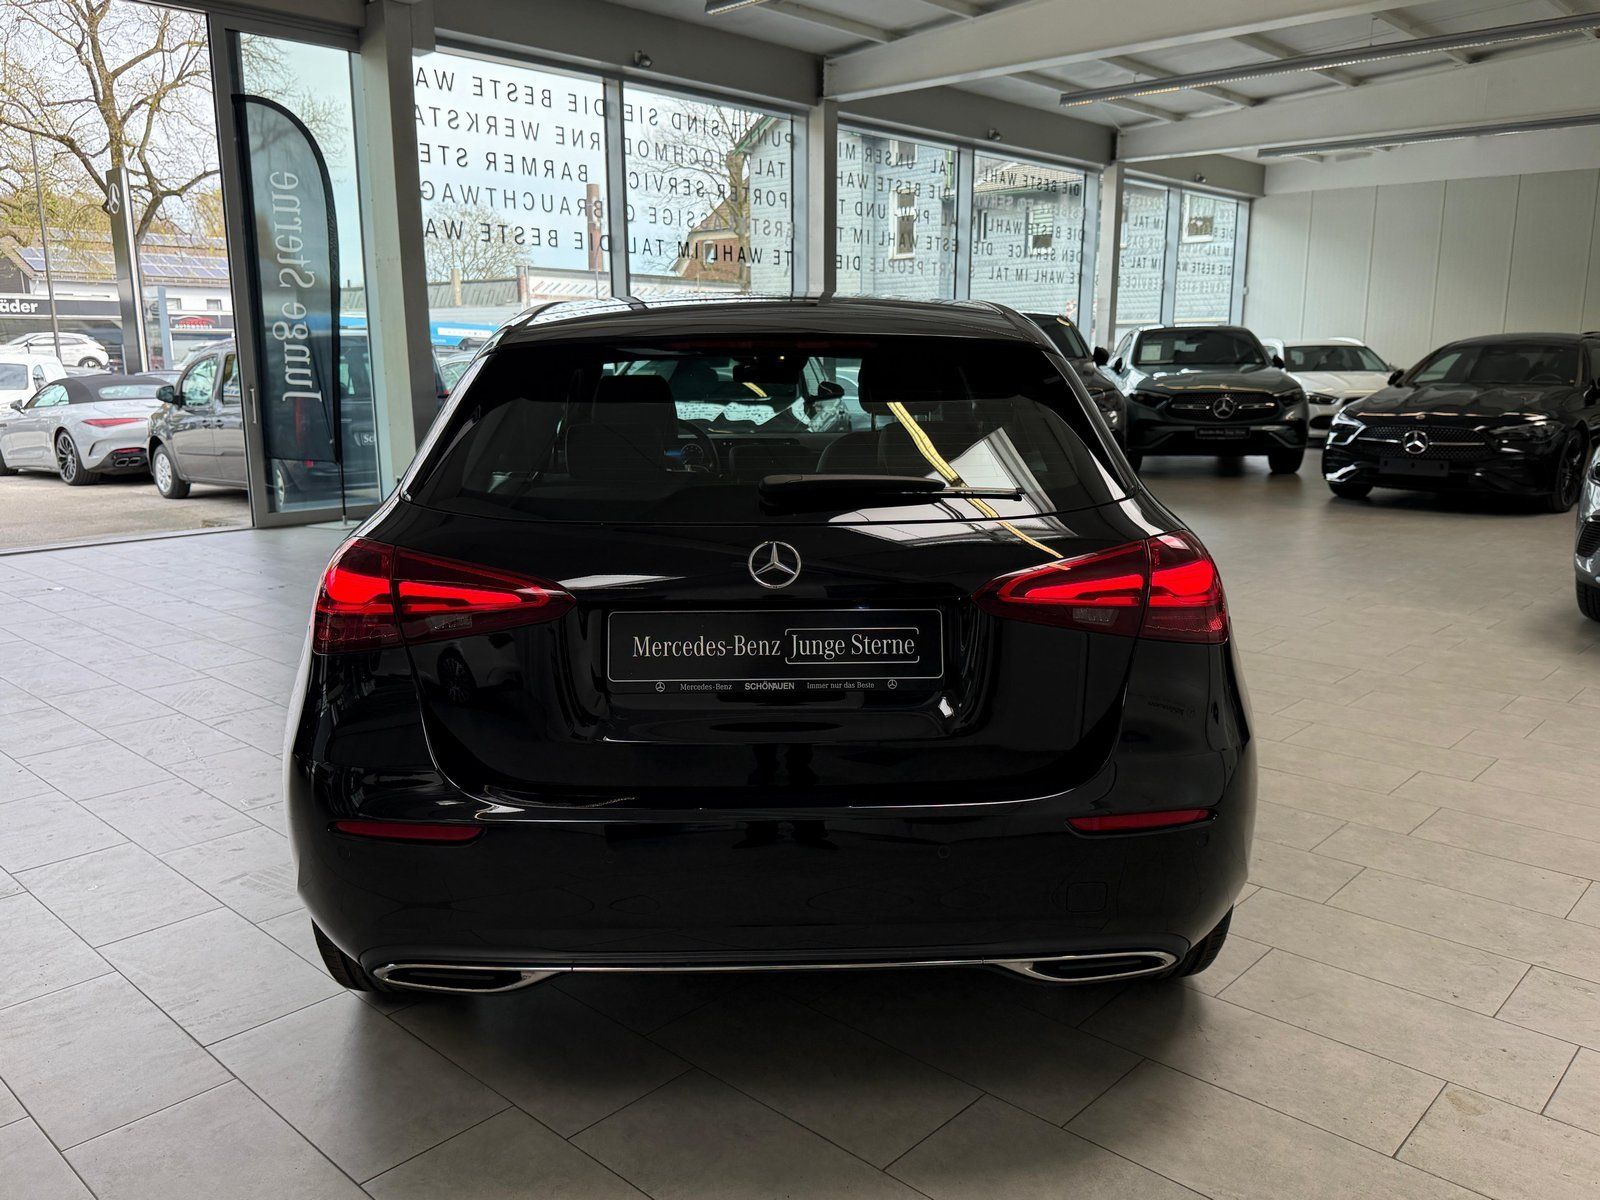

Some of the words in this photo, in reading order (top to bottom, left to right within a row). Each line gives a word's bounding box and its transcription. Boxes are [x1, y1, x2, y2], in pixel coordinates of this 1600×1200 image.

[632, 634, 781, 658] Mercedes-Benz
[790, 634, 846, 660] Junge
[850, 633, 916, 655] Sterne
[680, 683, 733, 691] Mercedes-Benz
[744, 681, 795, 691] SCHÖNAUEN
